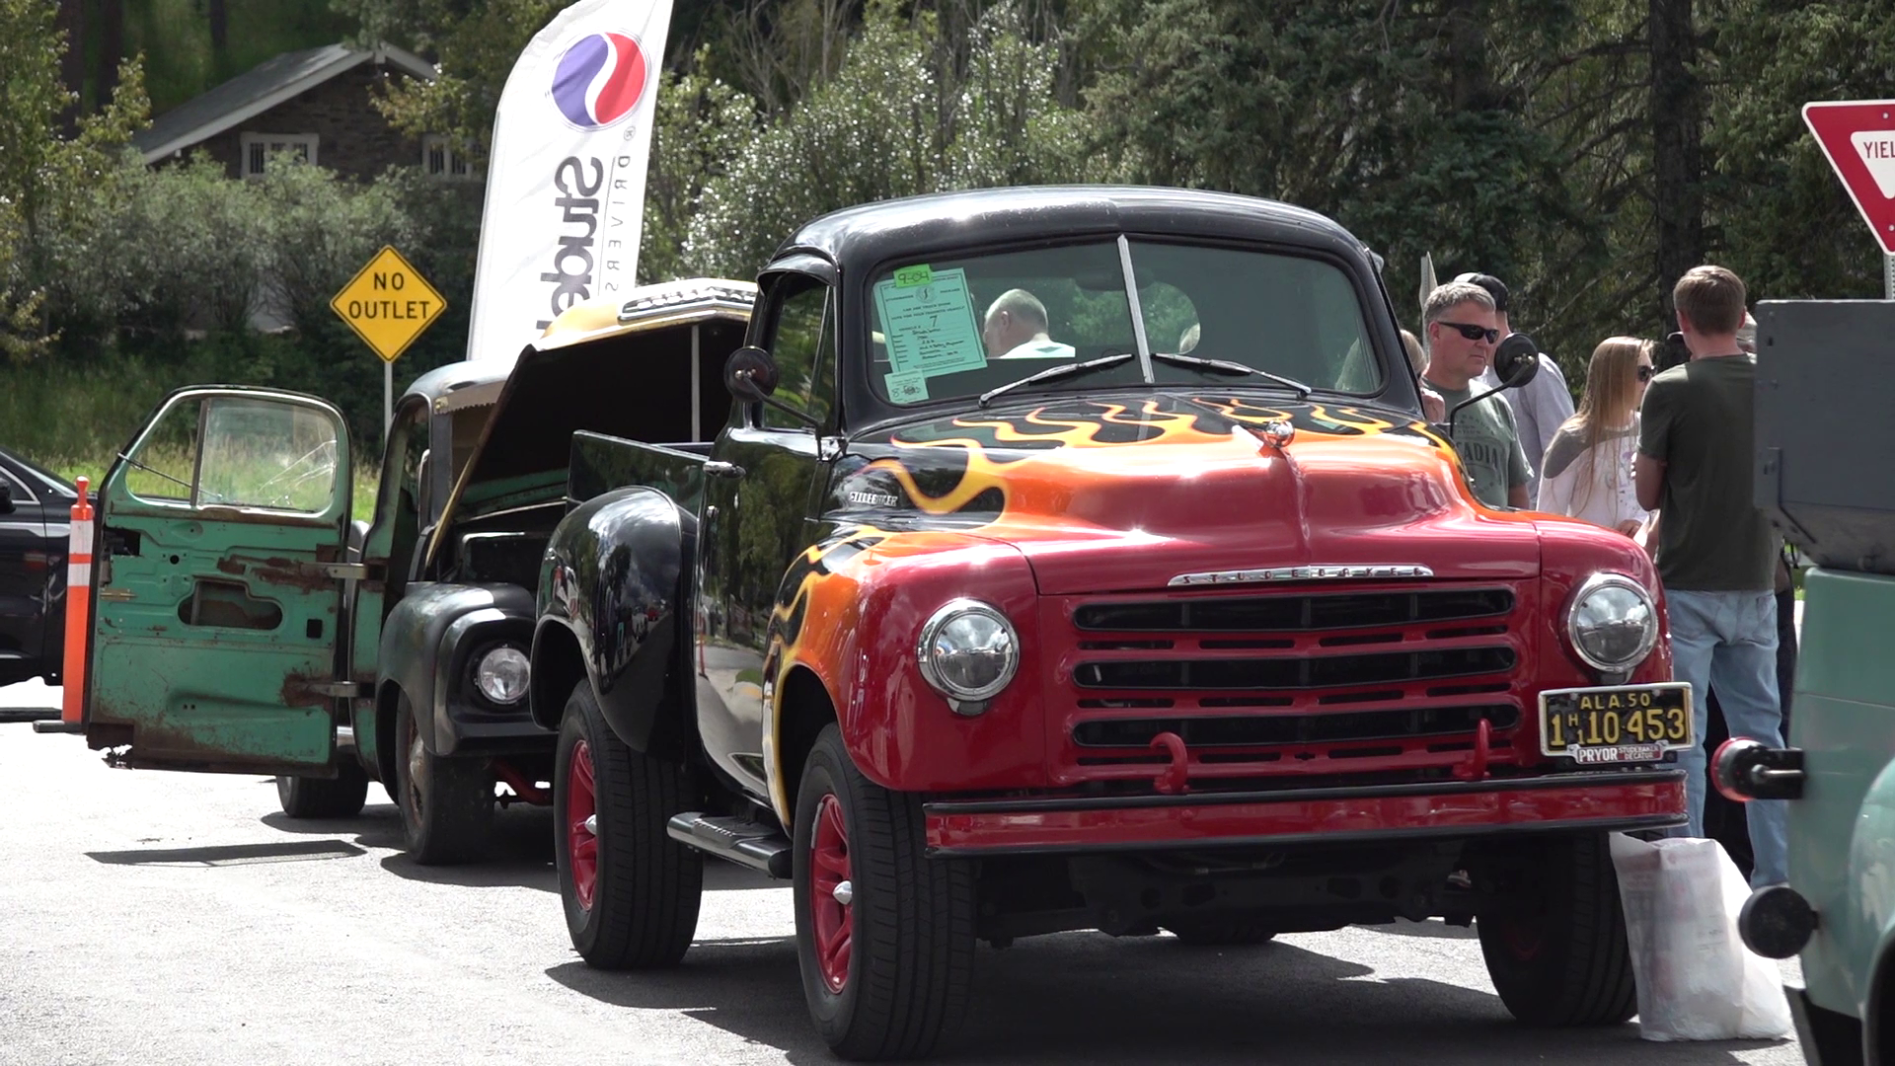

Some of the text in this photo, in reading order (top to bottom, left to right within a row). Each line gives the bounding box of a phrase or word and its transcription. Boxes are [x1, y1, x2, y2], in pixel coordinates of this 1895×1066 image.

[1863, 141, 1895, 159] YIEL
[374, 272, 404, 290] NO
[349, 300, 430, 319] OUTLET
[1579, 747, 1618, 762] PRYOR
